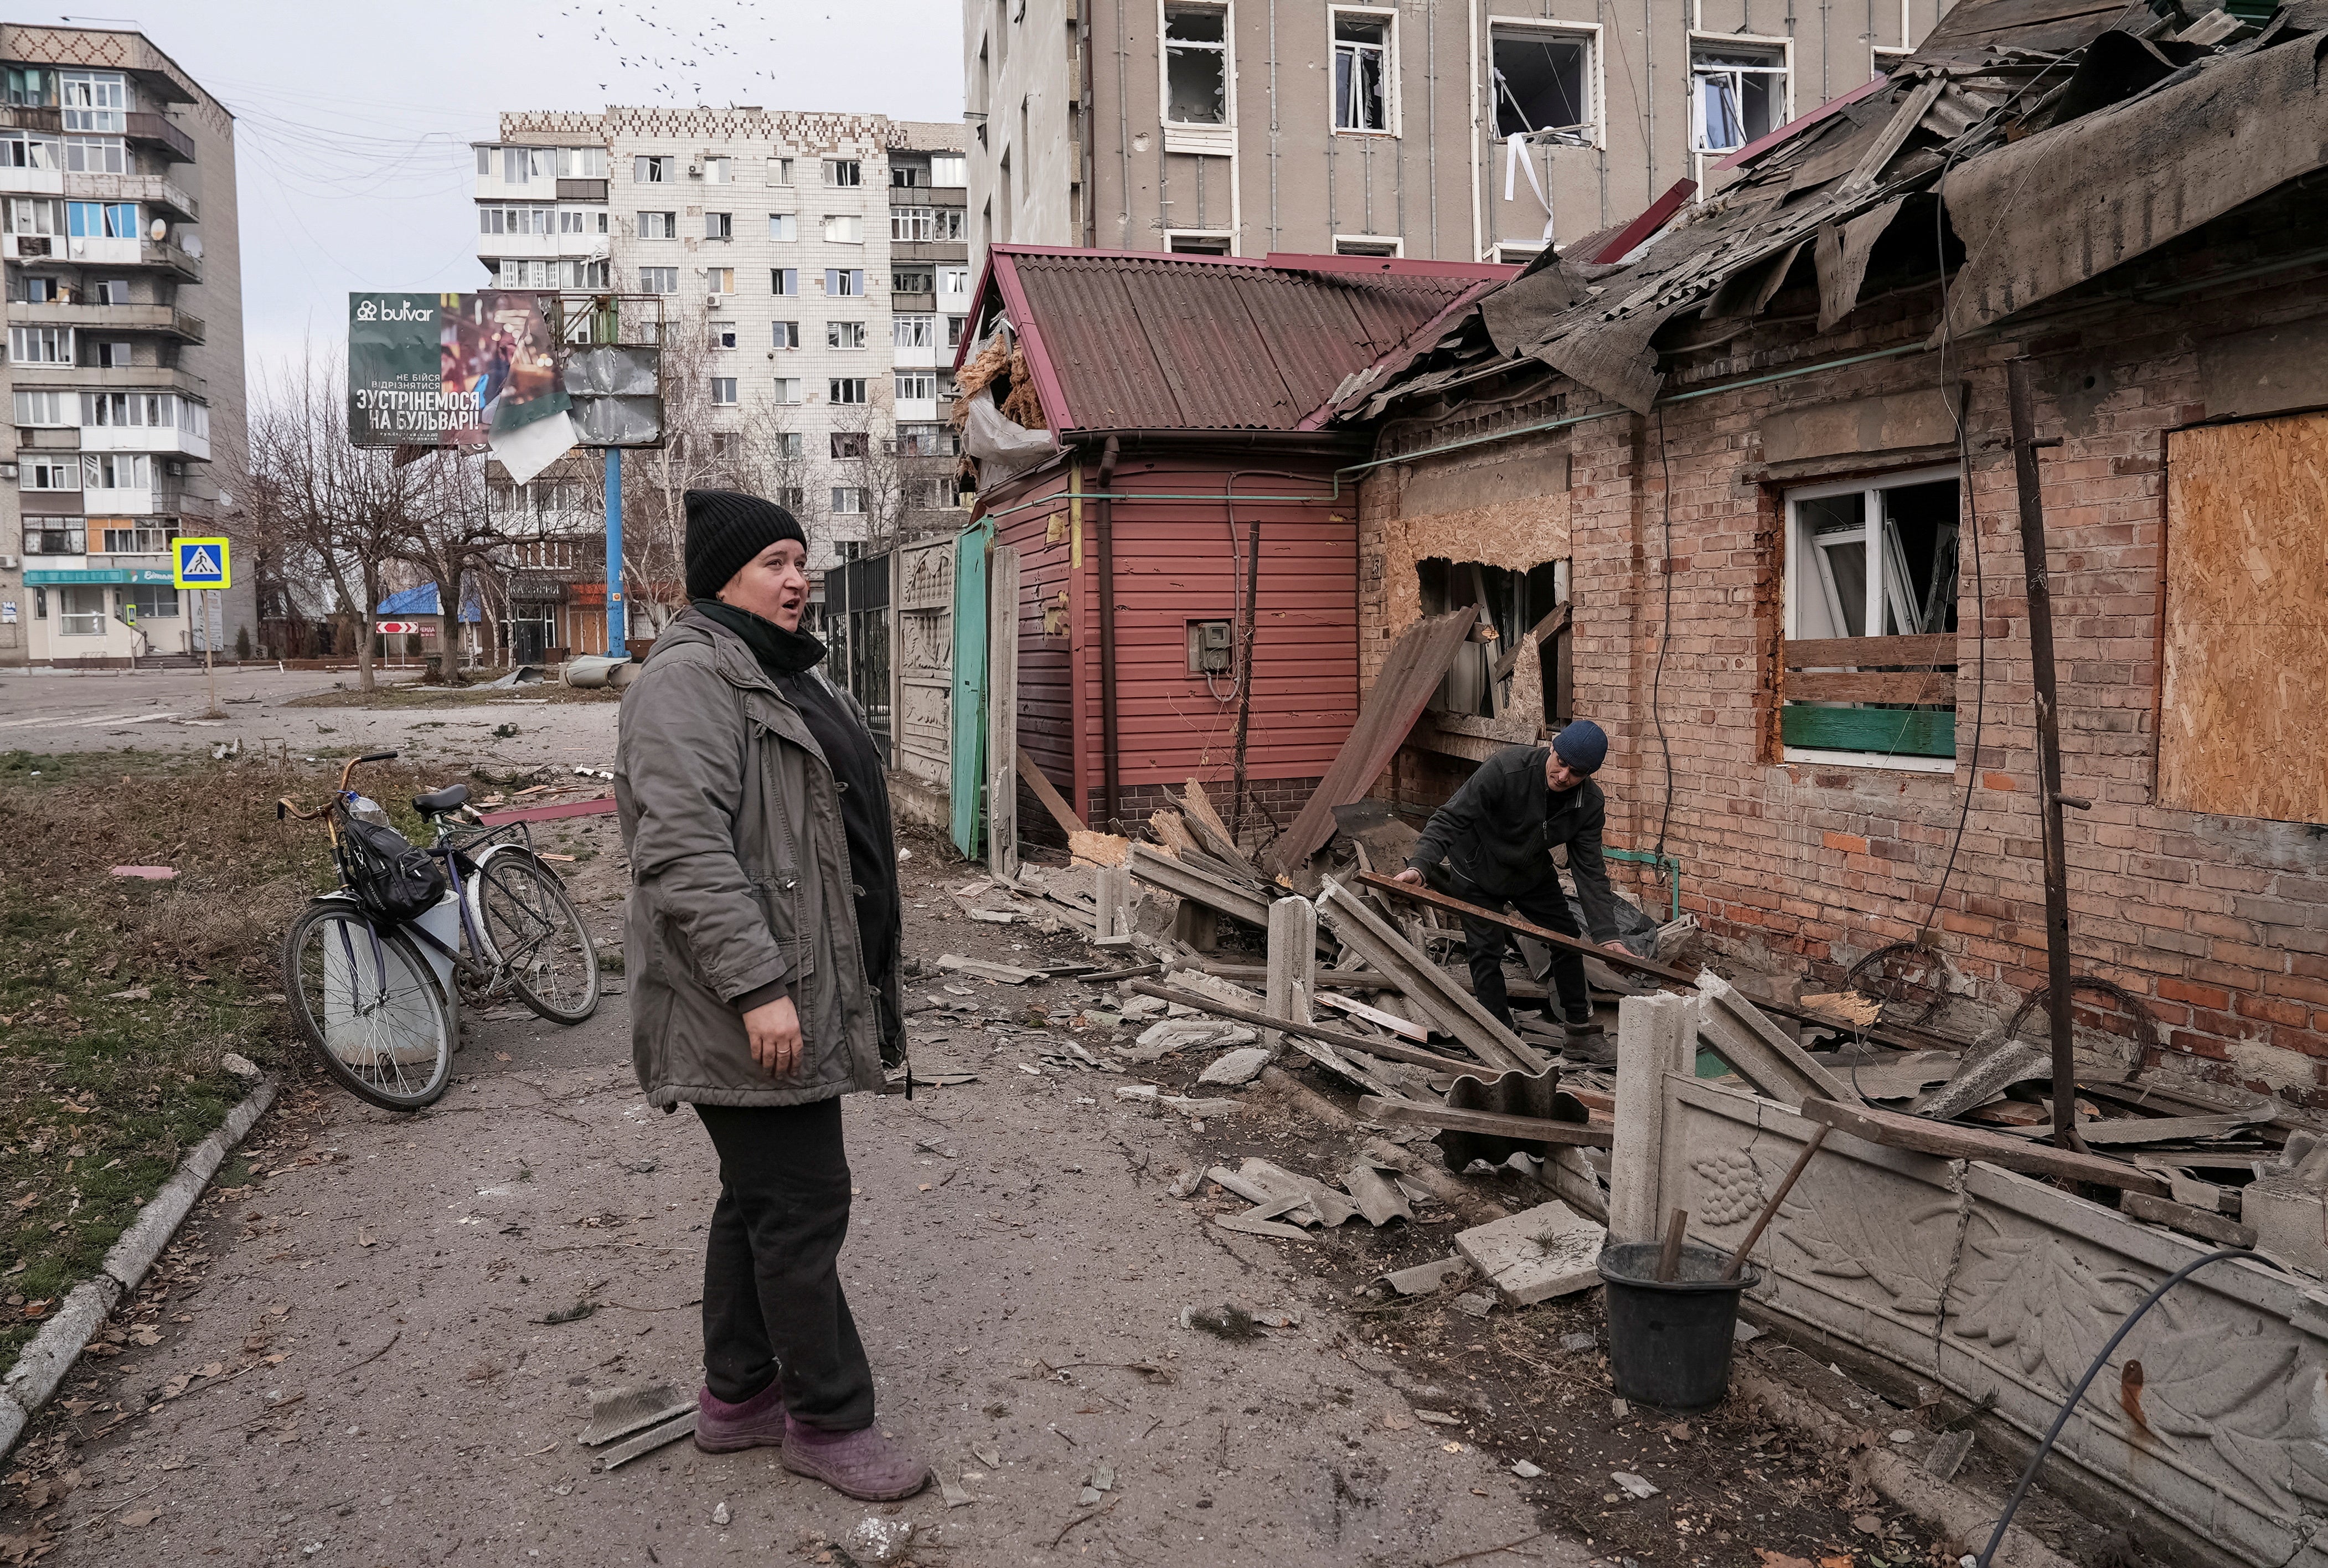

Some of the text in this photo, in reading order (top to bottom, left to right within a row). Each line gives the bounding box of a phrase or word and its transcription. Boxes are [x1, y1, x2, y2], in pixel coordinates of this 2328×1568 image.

[381, 300, 434, 322] bulvar
[371, 381, 441, 389] ВІДРІЗНЯТИСЯ
[412, 373, 440, 381] БІЙСЯ
[356, 389, 479, 410] ЗУСТРІНЕМОСЯ
[369, 410, 479, 430] НА БУЛЬВАРІ!
